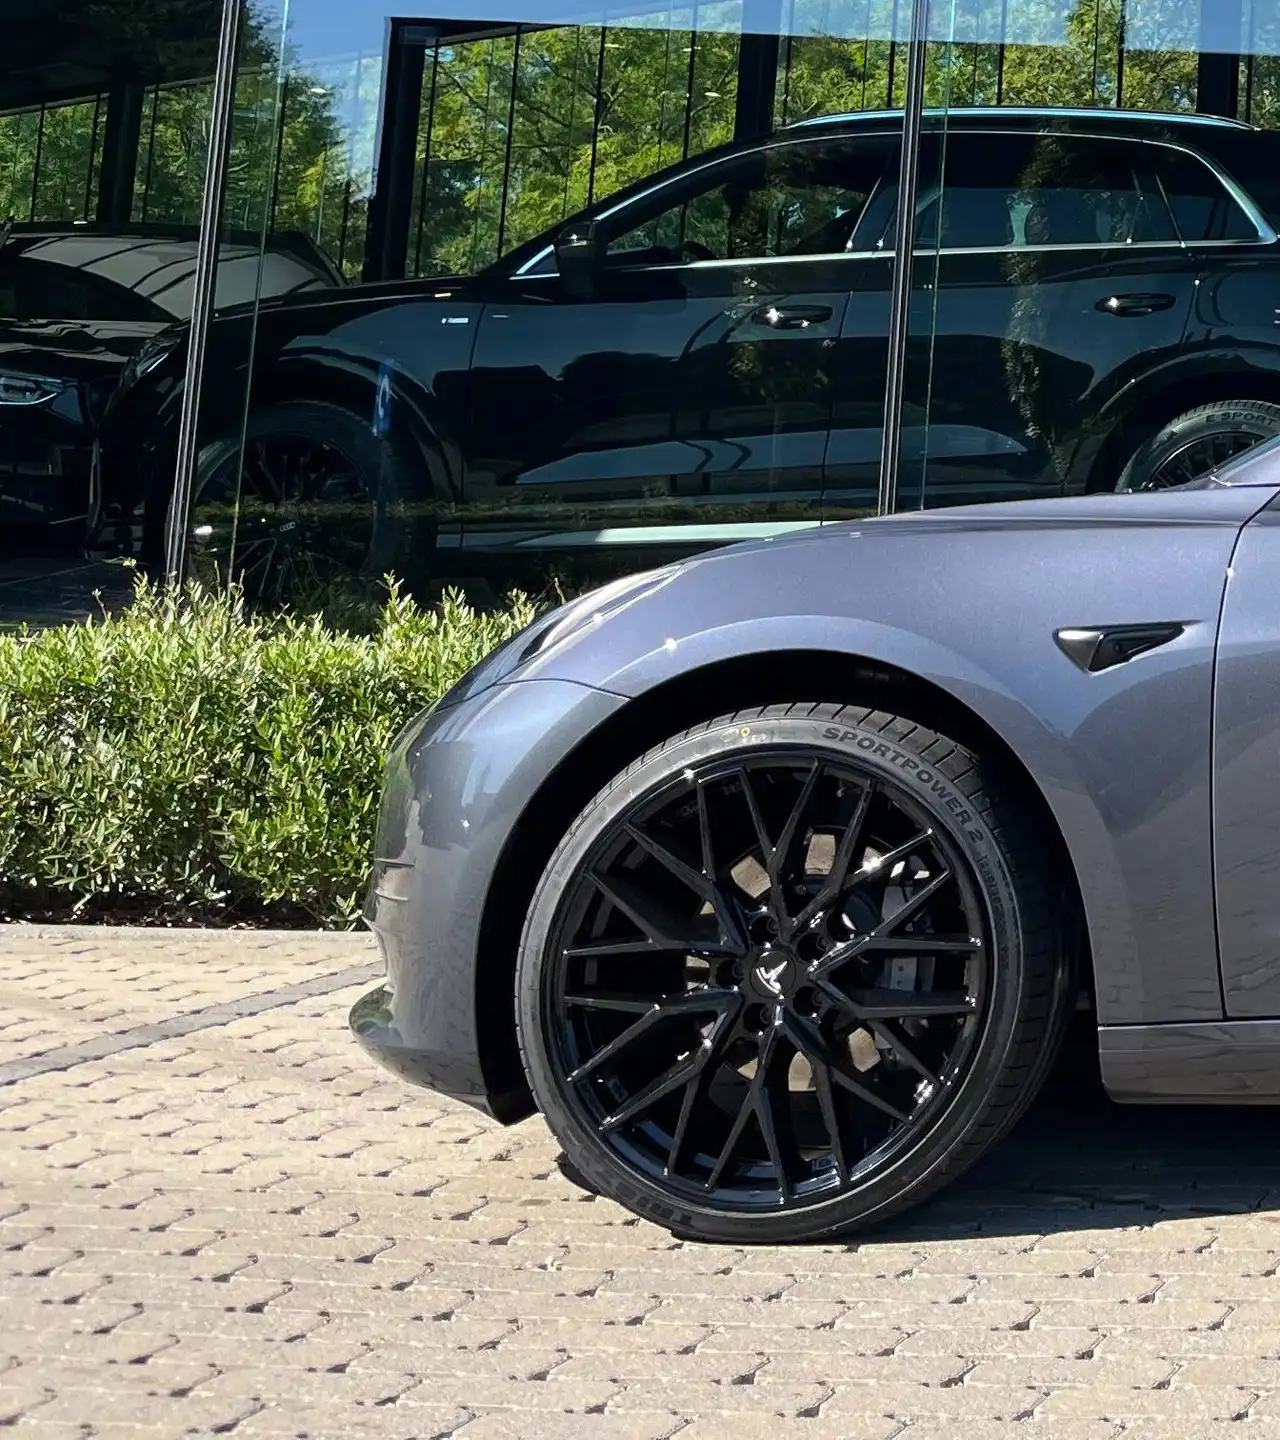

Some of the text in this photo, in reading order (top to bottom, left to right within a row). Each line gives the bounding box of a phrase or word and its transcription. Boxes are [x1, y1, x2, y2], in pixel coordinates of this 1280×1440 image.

[1221, 411, 1275, 425] SPORT
[822, 726, 984, 844] SPORTPOWER 2
